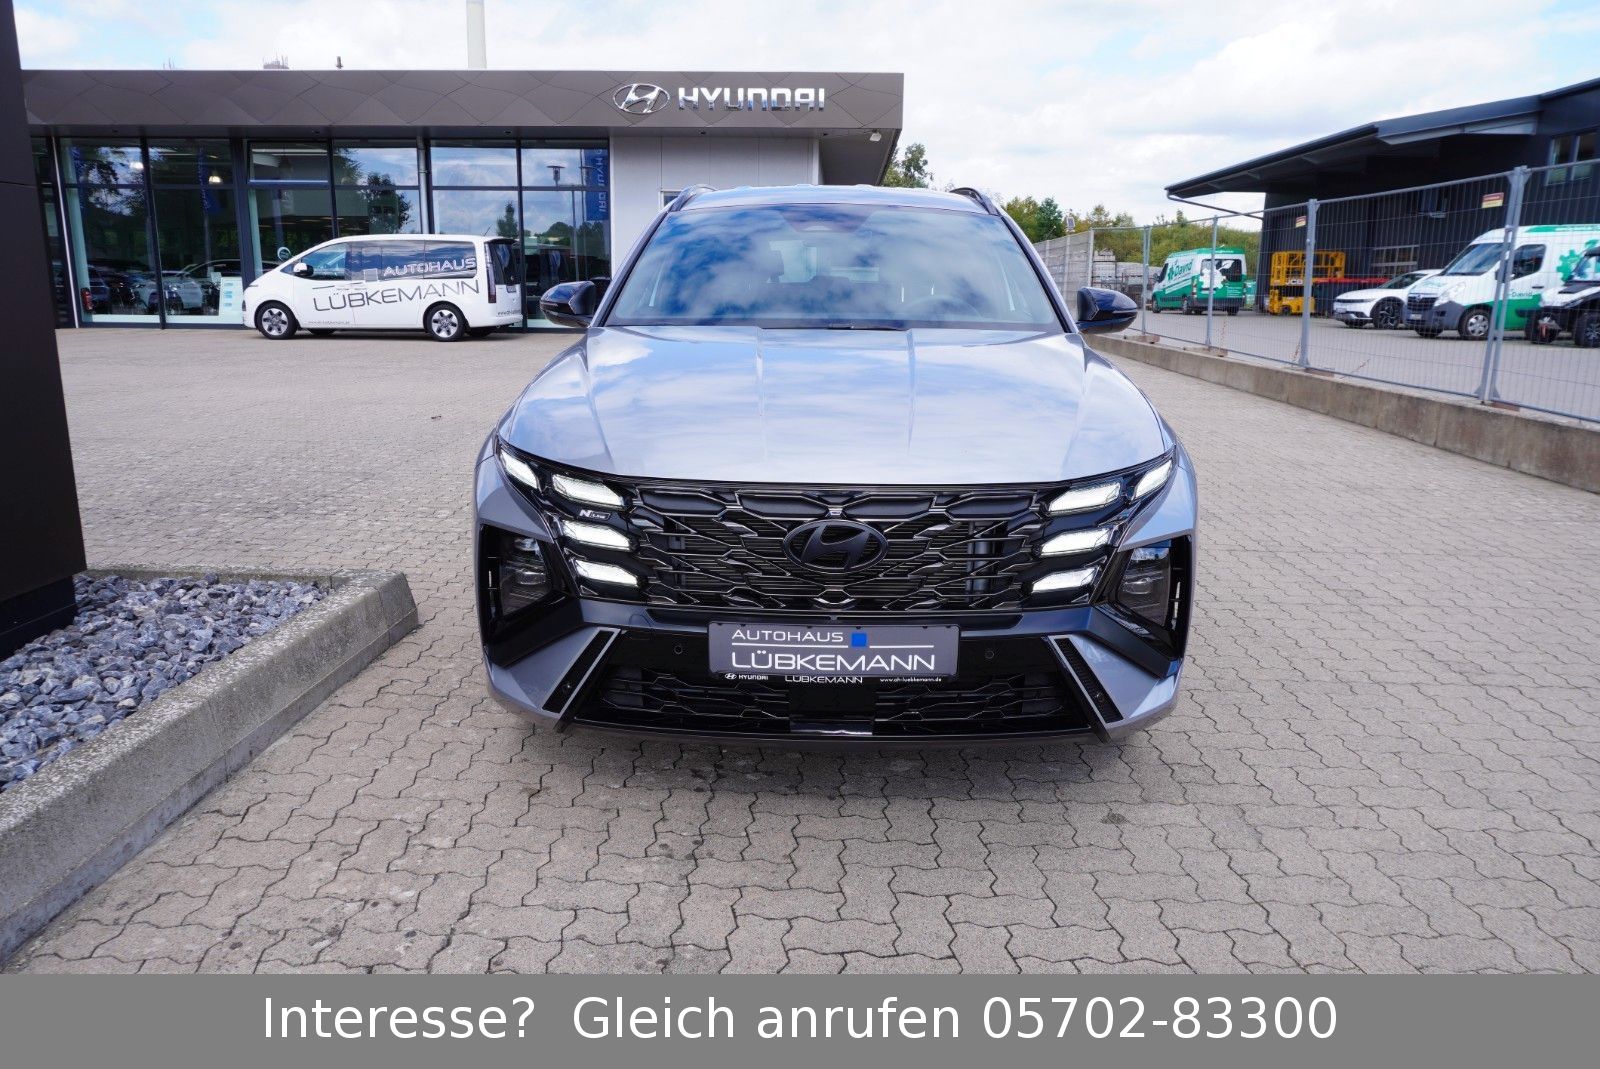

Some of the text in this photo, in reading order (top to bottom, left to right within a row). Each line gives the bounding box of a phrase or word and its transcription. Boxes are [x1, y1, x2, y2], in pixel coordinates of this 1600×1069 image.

[678, 87, 825, 112] HYUNDAI
[383, 257, 477, 277] AUTOHAUS
[313, 279, 480, 312] LÜBKEMANN
[732, 629, 844, 642] AUTOHAUS
[731, 650, 935, 671] LÜBKEMANN
